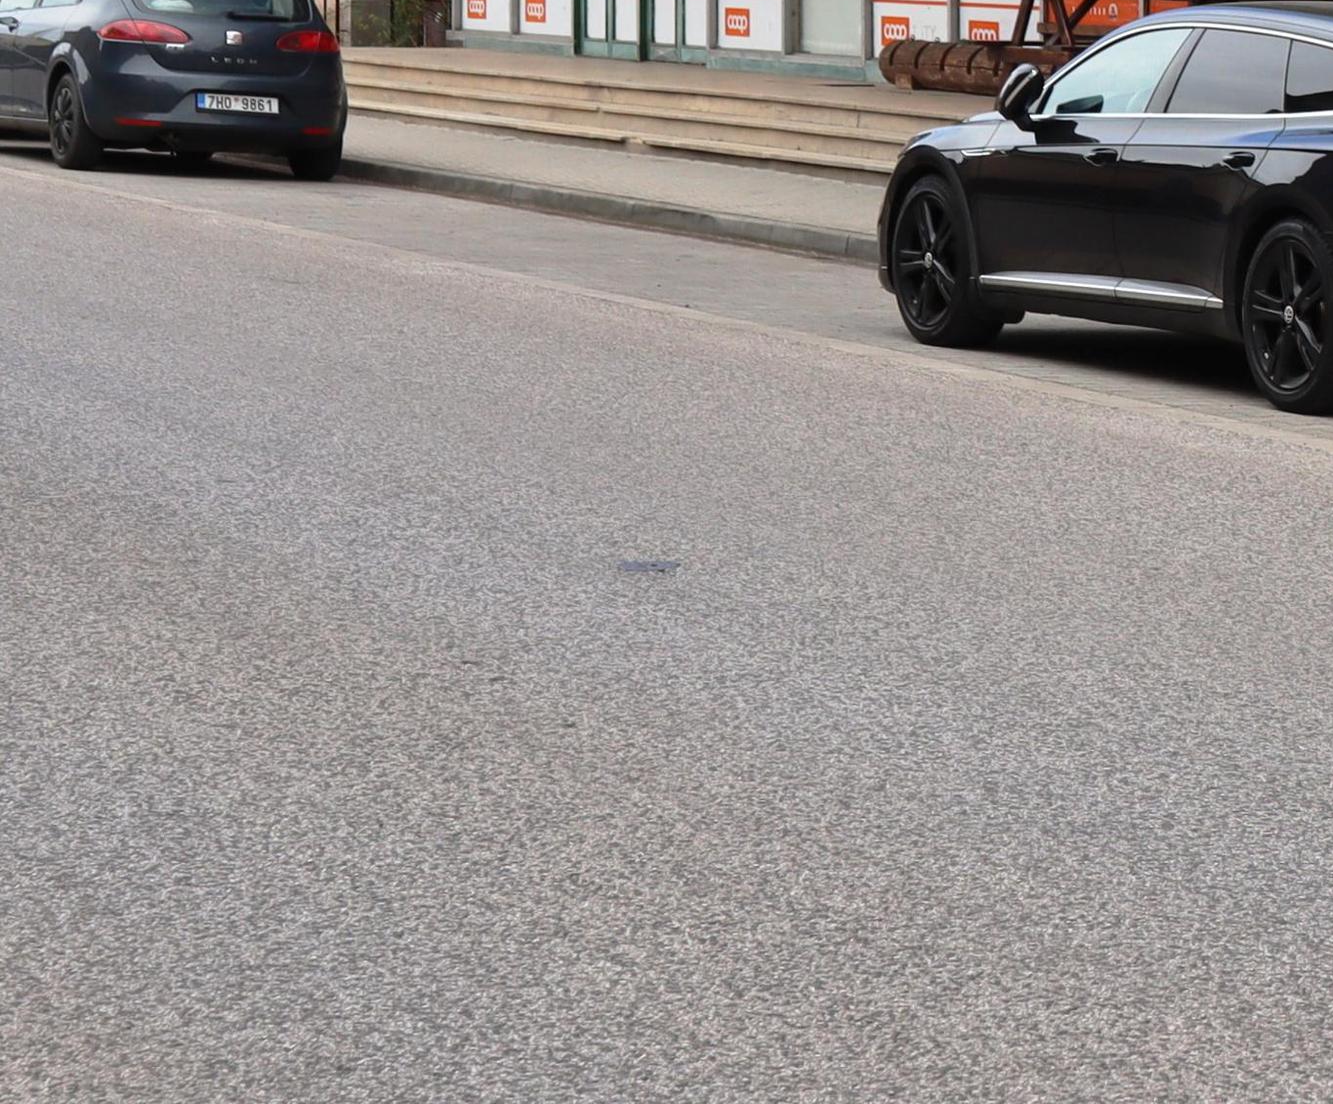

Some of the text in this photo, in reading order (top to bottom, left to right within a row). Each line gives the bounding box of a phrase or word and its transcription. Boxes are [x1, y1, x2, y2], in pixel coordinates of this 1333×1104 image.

[468, 0, 486, 17] coop
[527, 2, 545, 21] coop
[727, 14, 749, 34] coop
[241, 97, 273, 112] 9861
